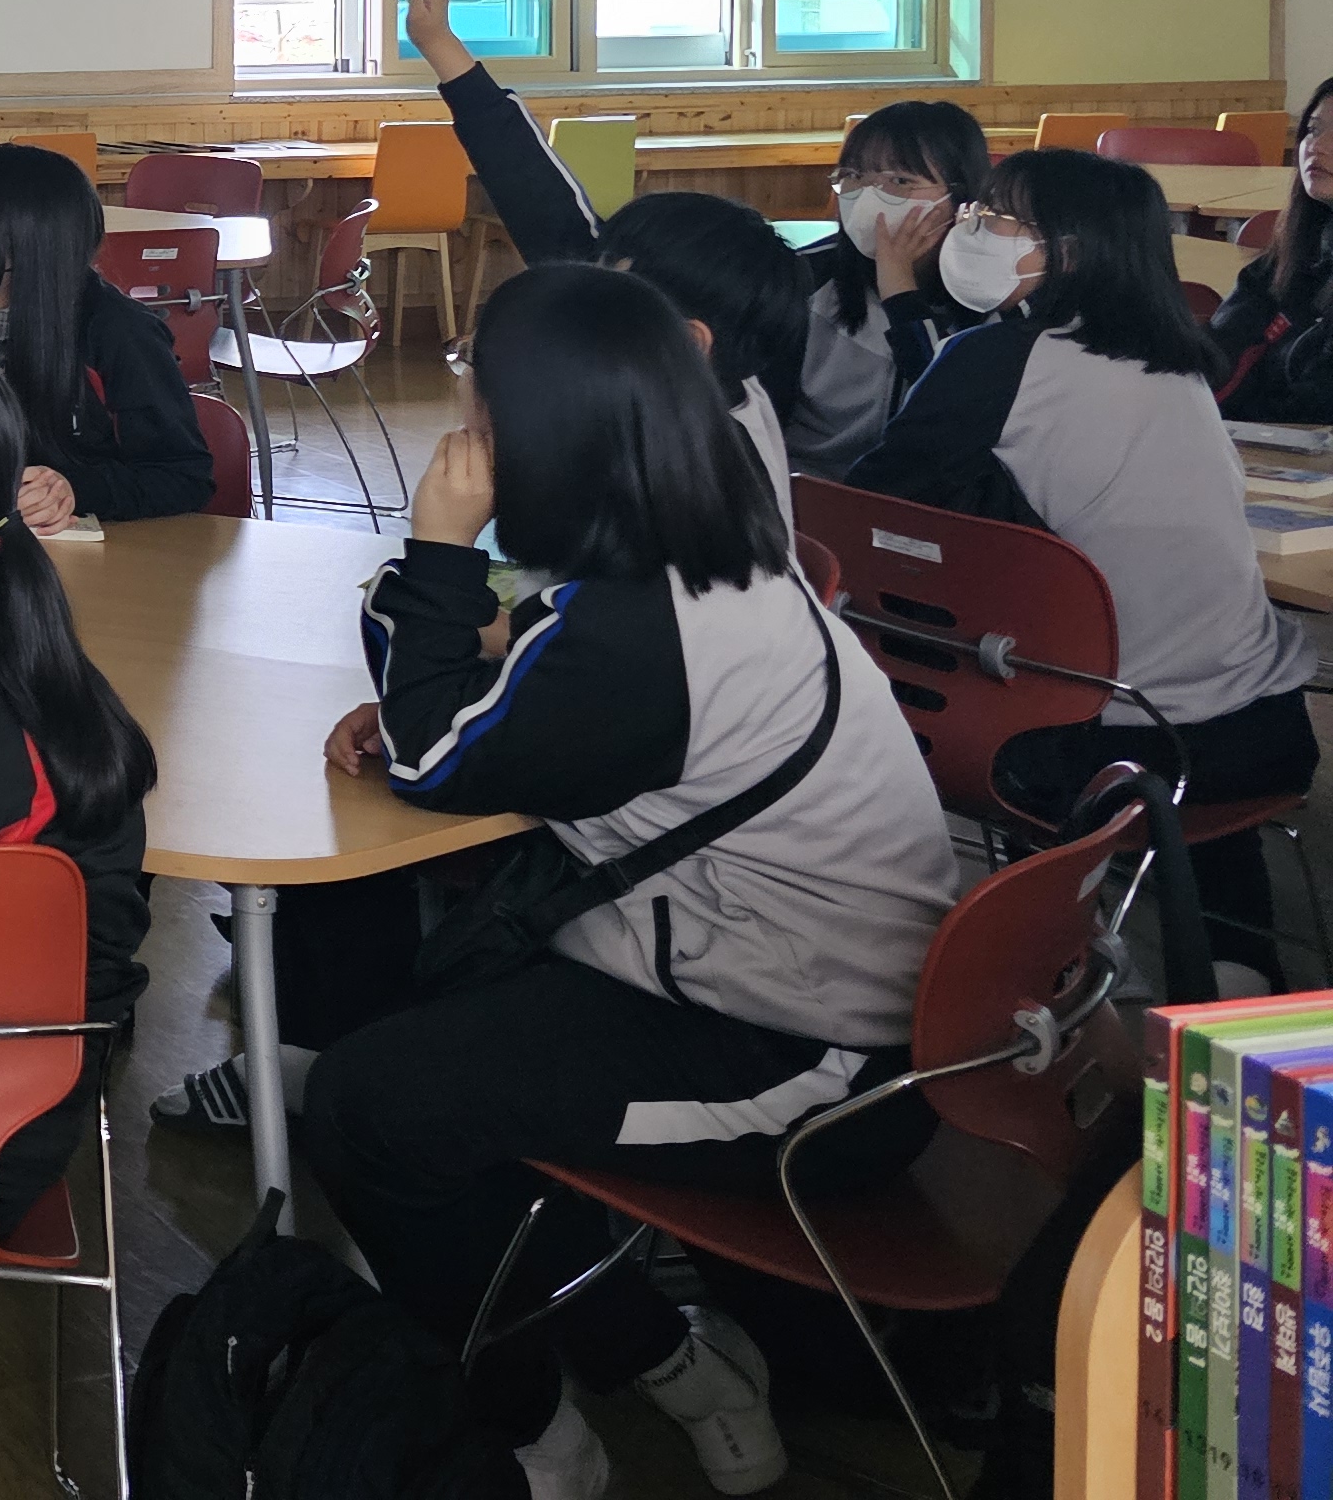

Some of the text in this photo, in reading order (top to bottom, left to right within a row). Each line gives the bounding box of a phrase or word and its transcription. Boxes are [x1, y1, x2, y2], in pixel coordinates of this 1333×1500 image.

[1144, 1228, 1165, 1296] 인간의
[1186, 1253, 1208, 1320] 인간의
[1144, 1297, 1164, 1323] 몸
[1146, 1324, 1163, 1343] 2
[1186, 1323, 1207, 1349] 몸
[1210, 1267, 1232, 1360] 찾아보기
[1243, 1282, 1266, 1332] 환경
[1188, 1356, 1206, 1368] 1
[1275, 1302, 1297, 1376] 생태계
[1307, 1321, 1332, 1419] 우주탐사
